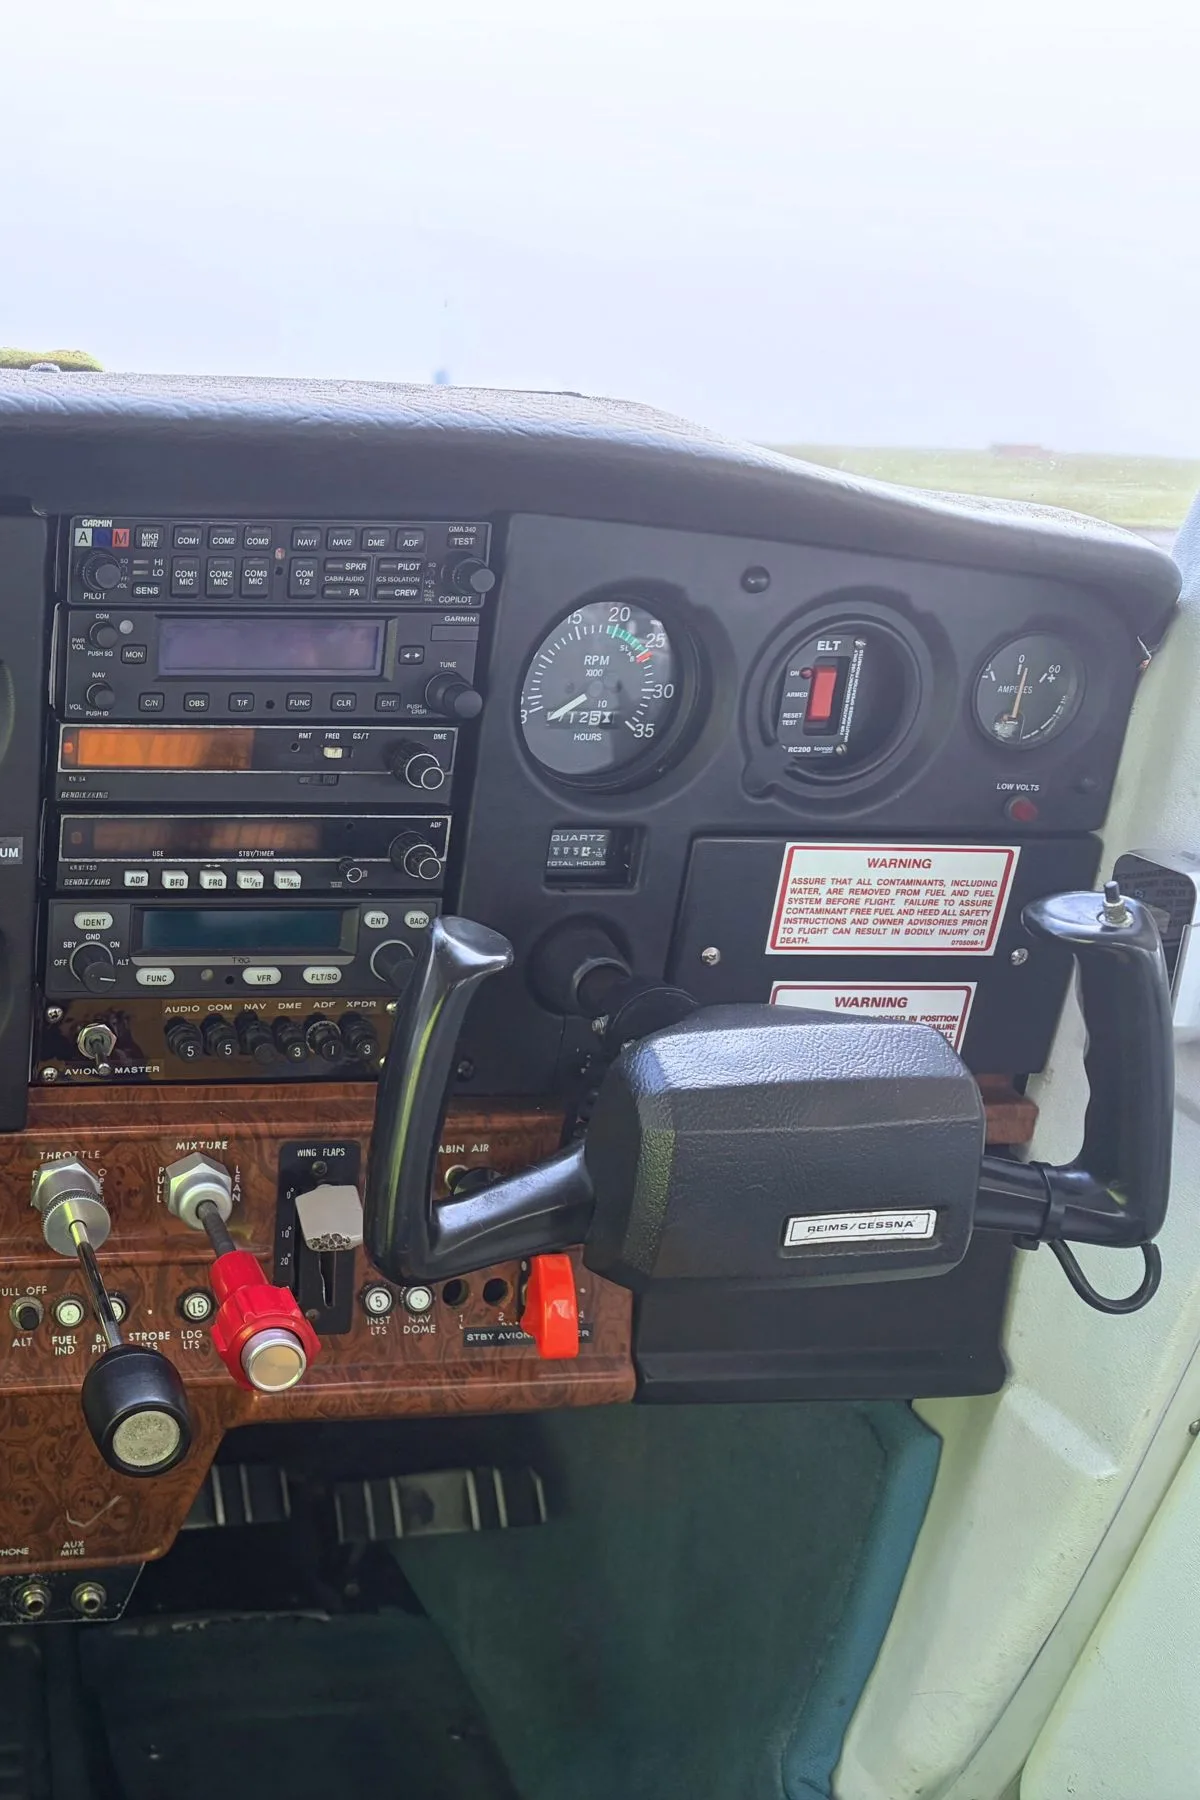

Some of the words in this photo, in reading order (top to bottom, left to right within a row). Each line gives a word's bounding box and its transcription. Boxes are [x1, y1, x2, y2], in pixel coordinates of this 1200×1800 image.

[608, 606, 630, 622] 20
[817, 641, 841, 650] ELT
[584, 656, 610, 665] RPM
[653, 684, 674, 698] 30
[574, 733, 602, 741] HOURS
[867, 858, 932, 868] WARNING
[876, 879, 946, 887] CONTAMINANTS,
[834, 997, 908, 1008] WARNING
[176, 1141, 228, 1150] MIXTURE
[297, 1148, 316, 1157] WING
[323, 1148, 345, 1156] FLAPS
[807, 1221, 913, 1232] REIMS/CESSNA
[404, 1325, 436, 1334] DOME
[129, 1331, 170, 1341] STROBE
